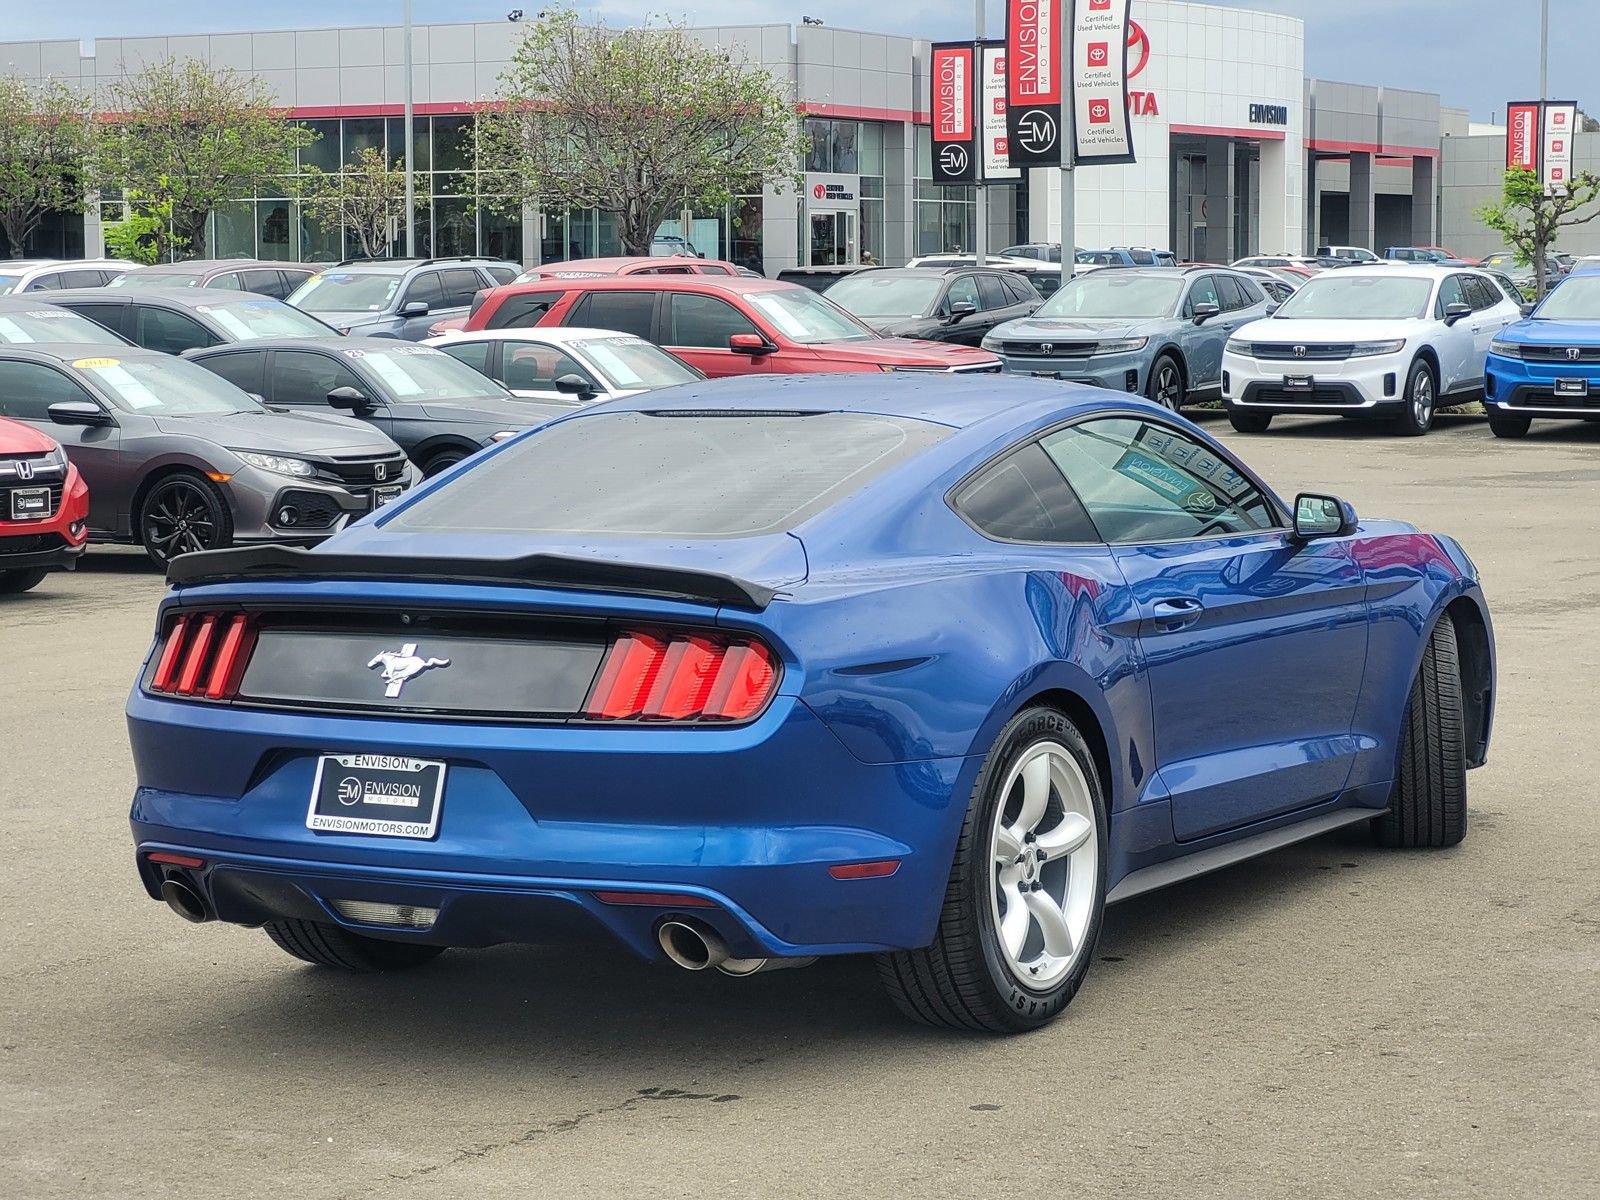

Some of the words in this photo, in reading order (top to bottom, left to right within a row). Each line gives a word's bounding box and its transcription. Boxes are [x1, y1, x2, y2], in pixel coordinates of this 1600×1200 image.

[1085, 15, 1113, 23] Certified
[1019, 0, 1037, 95] ENVISIO
[1040, 0, 1048, 85] MOTOR
[1093, 80, 1119, 88] Vehicles
[941, 56, 954, 134] ENVISION
[1249, 103, 1287, 125] ENVISION
[1087, 128, 1115, 136] Certified
[1096, 136, 1125, 144] Vehicles
[1513, 111, 1524, 165] ENVISION
[354, 755, 409, 769] ENVISION
[364, 781, 421, 797] ENVISION
[367, 796, 415, 805] MOTORS
[312, 817, 429, 836] ENVISIONMOTORS.COM
